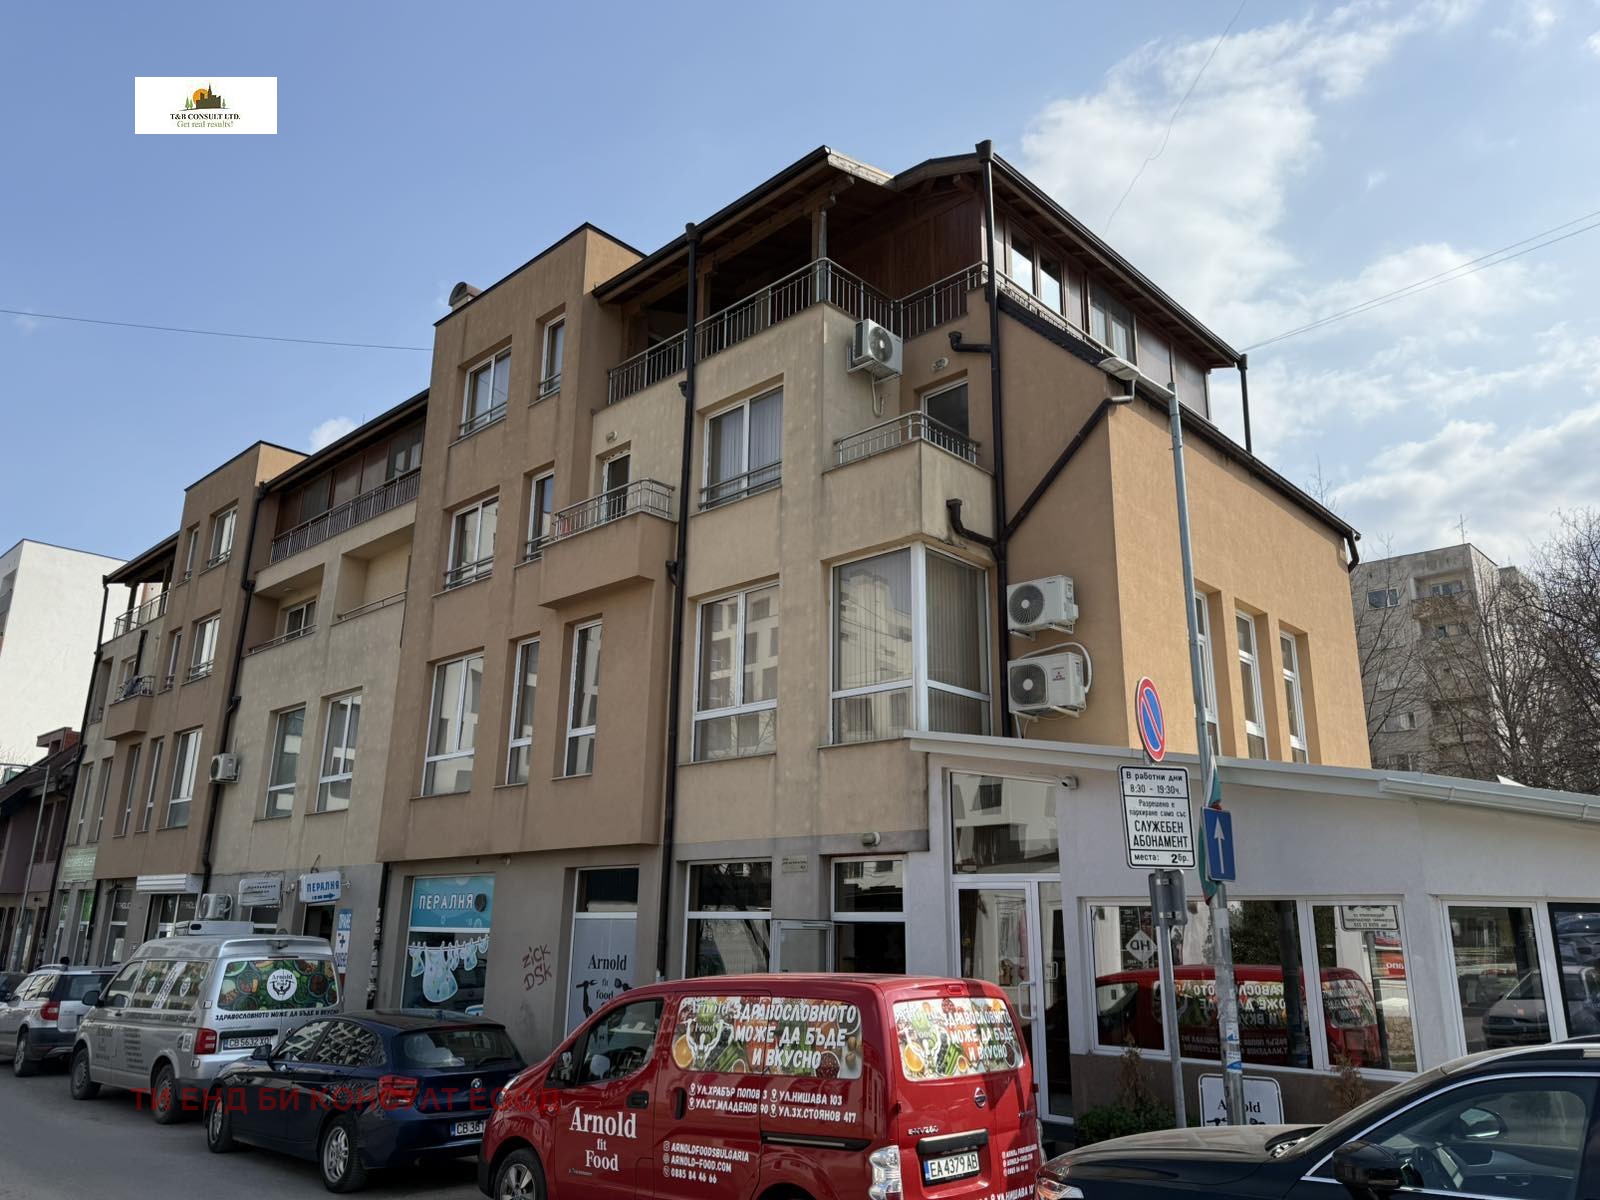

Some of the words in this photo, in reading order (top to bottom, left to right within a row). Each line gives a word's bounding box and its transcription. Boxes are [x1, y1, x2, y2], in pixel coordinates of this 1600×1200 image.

[1126, 771, 1132, 779] В
[1134, 772, 1166, 781] работни
[1130, 783, 1146, 794] 8:30
[1129, 809, 1159, 818] паркиране
[1134, 819, 1184, 834] СЛУЖЕБЕН
[1133, 834, 1188, 849] АБОНАМЕНТ
[1134, 854, 1160, 862] места:
[306, 880, 340, 893] ПЕРАЛНЯ
[418, 893, 475, 911] ПЕРАЛНЯ
[587, 954, 628, 972] Arnold
[601, 978, 609, 987] fit
[595, 988, 615, 1000] food
[270, 1011, 287, 1019] МОЖЕ
[289, 1011, 298, 1019] ДА
[732, 1003, 857, 1024] ЗДРАВОСЛОВНОТО
[240, 1037, 258, 1047] 5632
[734, 1025, 776, 1043] МОЖЕ
[778, 1028, 800, 1048] ДА
[805, 1027, 848, 1049] БЪДЕ
[950, 1029, 977, 1044] МОЖЕ
[981, 1027, 993, 1042] ДА
[994, 1027, 1014, 1041] БЪДЕ
[751, 1047, 763, 1066] И
[766, 1048, 822, 1069] ВКУСНО
[979, 1044, 1008, 1060] ВКУСНО
[736, 1087, 761, 1099] ПОПОВ
[762, 1090, 767, 1100] 3
[779, 1090, 827, 1105] УЛ.НИШАВА
[829, 1094, 843, 1106] 103
[760, 1103, 768, 1114] 90
[843, 1112, 857, 1123] 417
[569, 1106, 637, 1139] Arnold
[596, 1138, 607, 1151] fit
[671, 1142, 749, 1163] ARNOLDFOODSBULGARIA
[585, 1150, 619, 1172] Food
[671, 1155, 732, 1173] ARNOLD-FOOD.COM
[944, 1156, 965, 1175] 4379
[671, 1168, 686, 1180] 0885
[688, 1170, 697, 1181] 84
[698, 1172, 707, 1183] 46
[708, 1173, 717, 1184] 66
